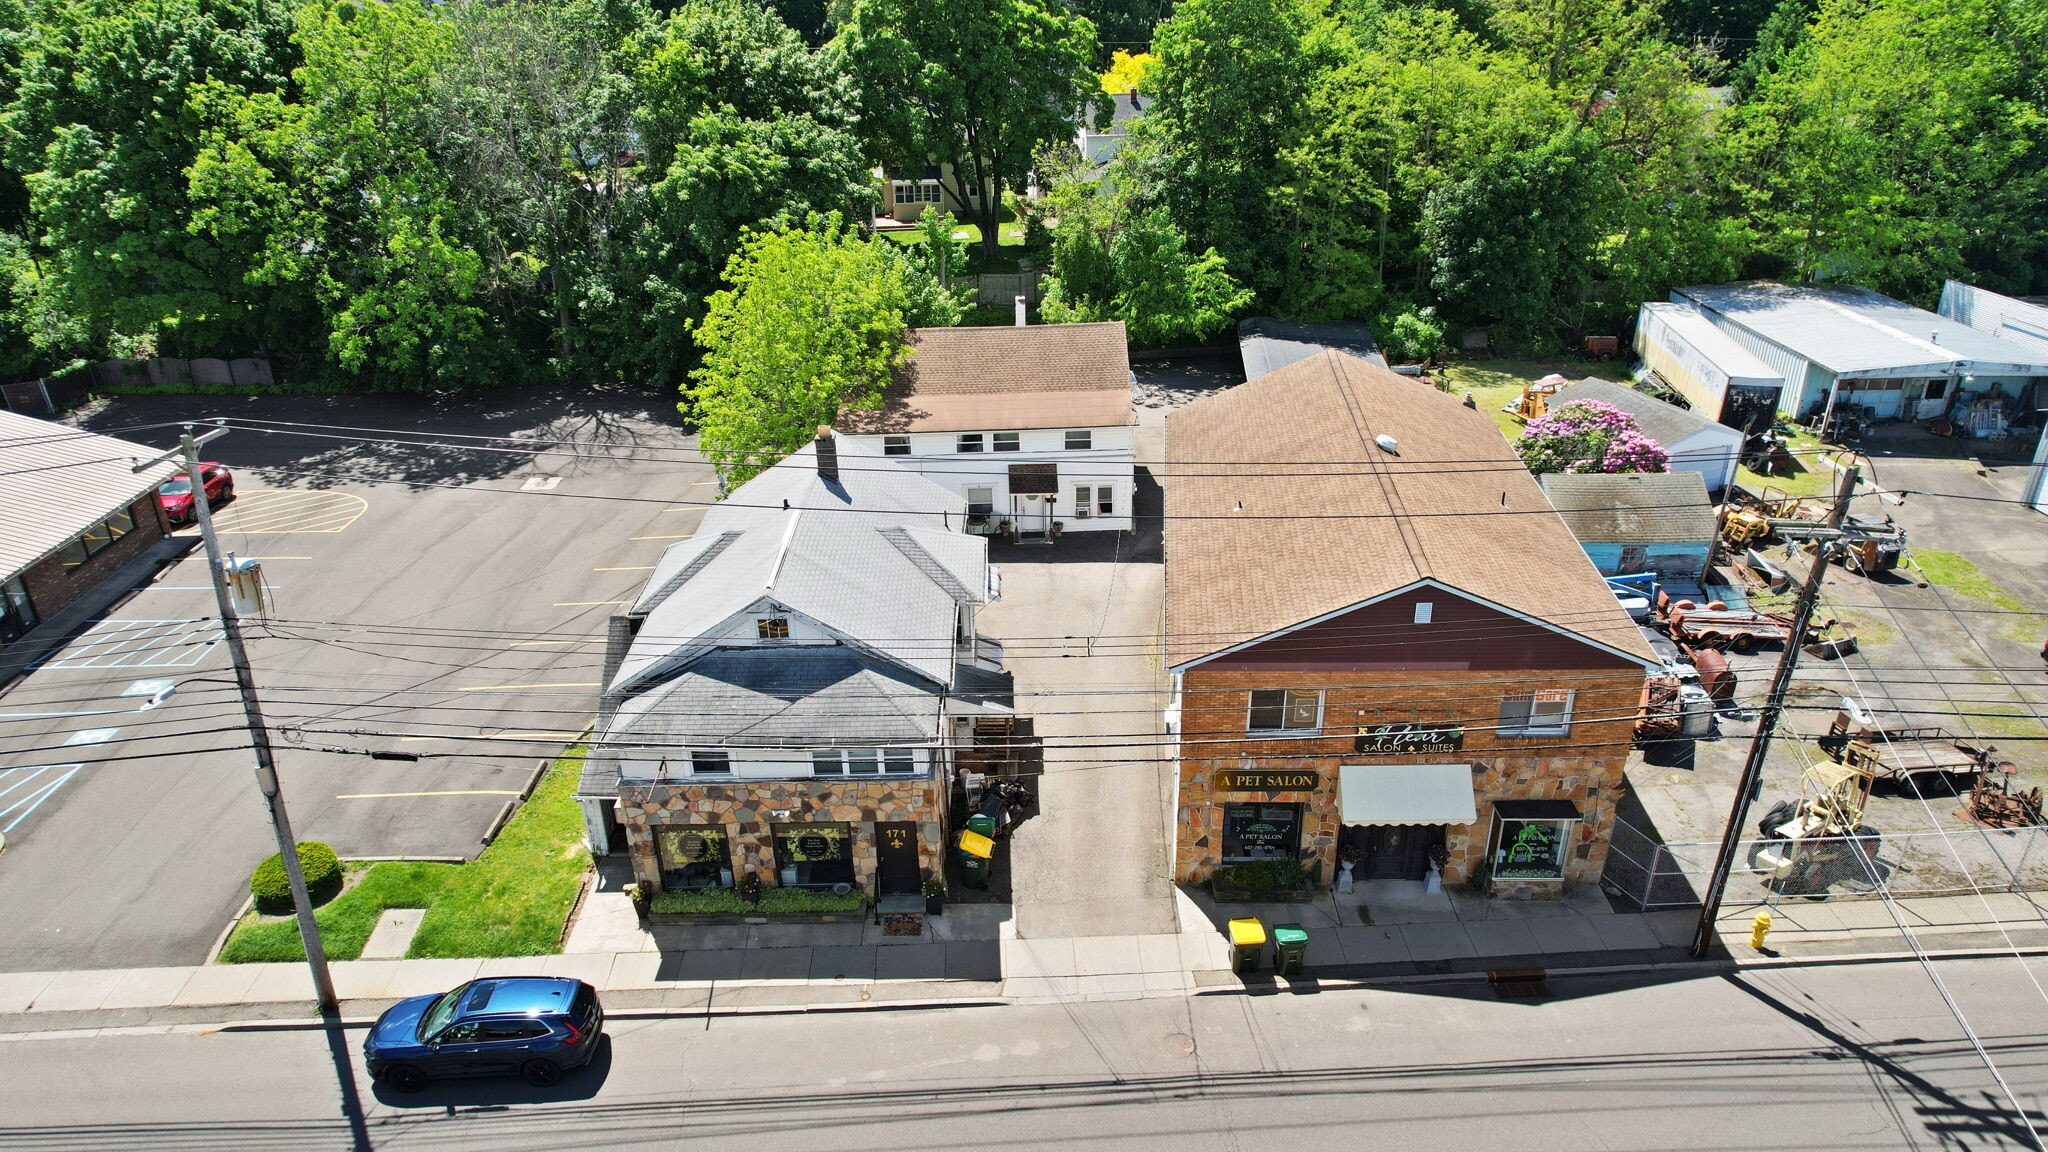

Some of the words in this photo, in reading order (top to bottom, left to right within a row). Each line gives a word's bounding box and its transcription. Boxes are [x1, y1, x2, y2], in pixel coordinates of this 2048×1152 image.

[1363, 744, 1401, 752] SALON
[1422, 743, 1454, 752] SUITES
[1221, 776, 1230, 786] A
[1236, 775, 1263, 786] PET
[1267, 775, 1313, 786] SALON
[886, 829, 906, 838] 171
